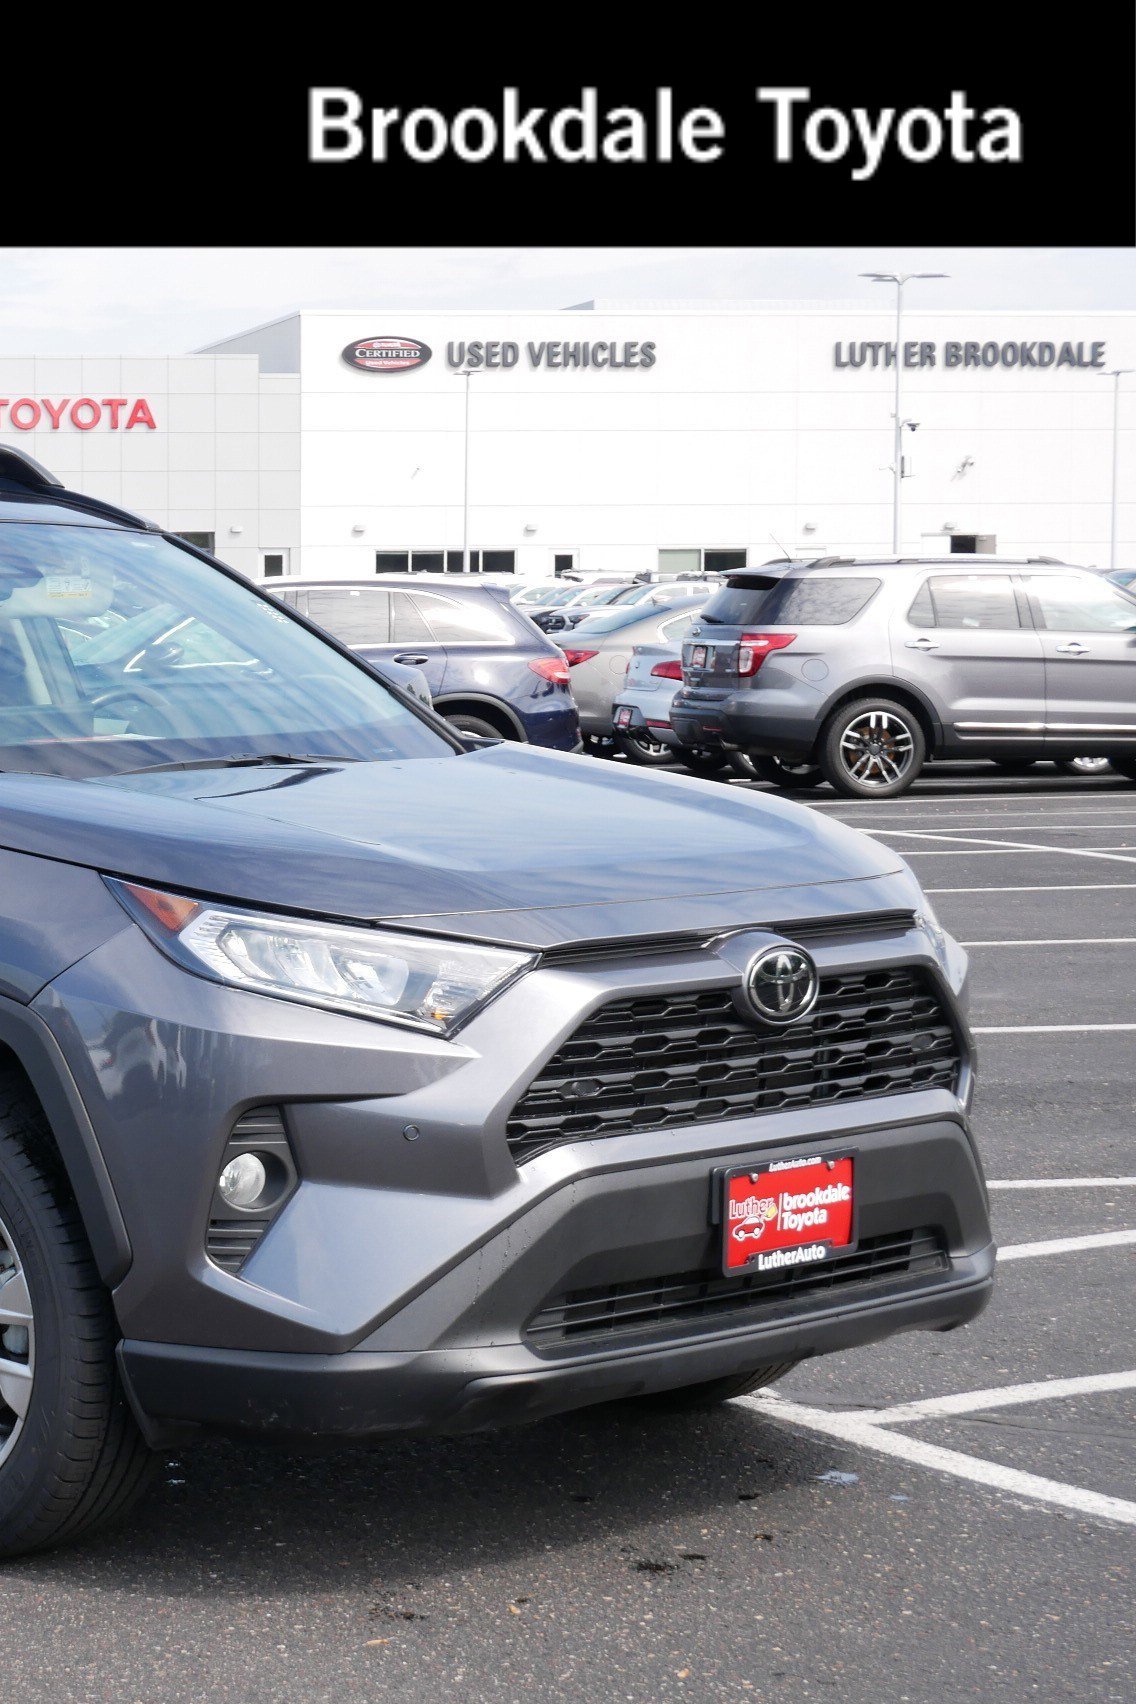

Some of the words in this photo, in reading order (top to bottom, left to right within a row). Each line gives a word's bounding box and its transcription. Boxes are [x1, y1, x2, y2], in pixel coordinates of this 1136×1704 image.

[447, 341, 519, 368] USED
[528, 341, 656, 368] VEHICLES
[835, 341, 936, 367] LUTHER
[945, 341, 1106, 367] BROOKDALE
[729, 1195, 775, 1220] Luther
[783, 1182, 851, 1211] brookdale
[781, 1207, 828, 1232] Toyota
[758, 1244, 826, 1271] LutherAuto
